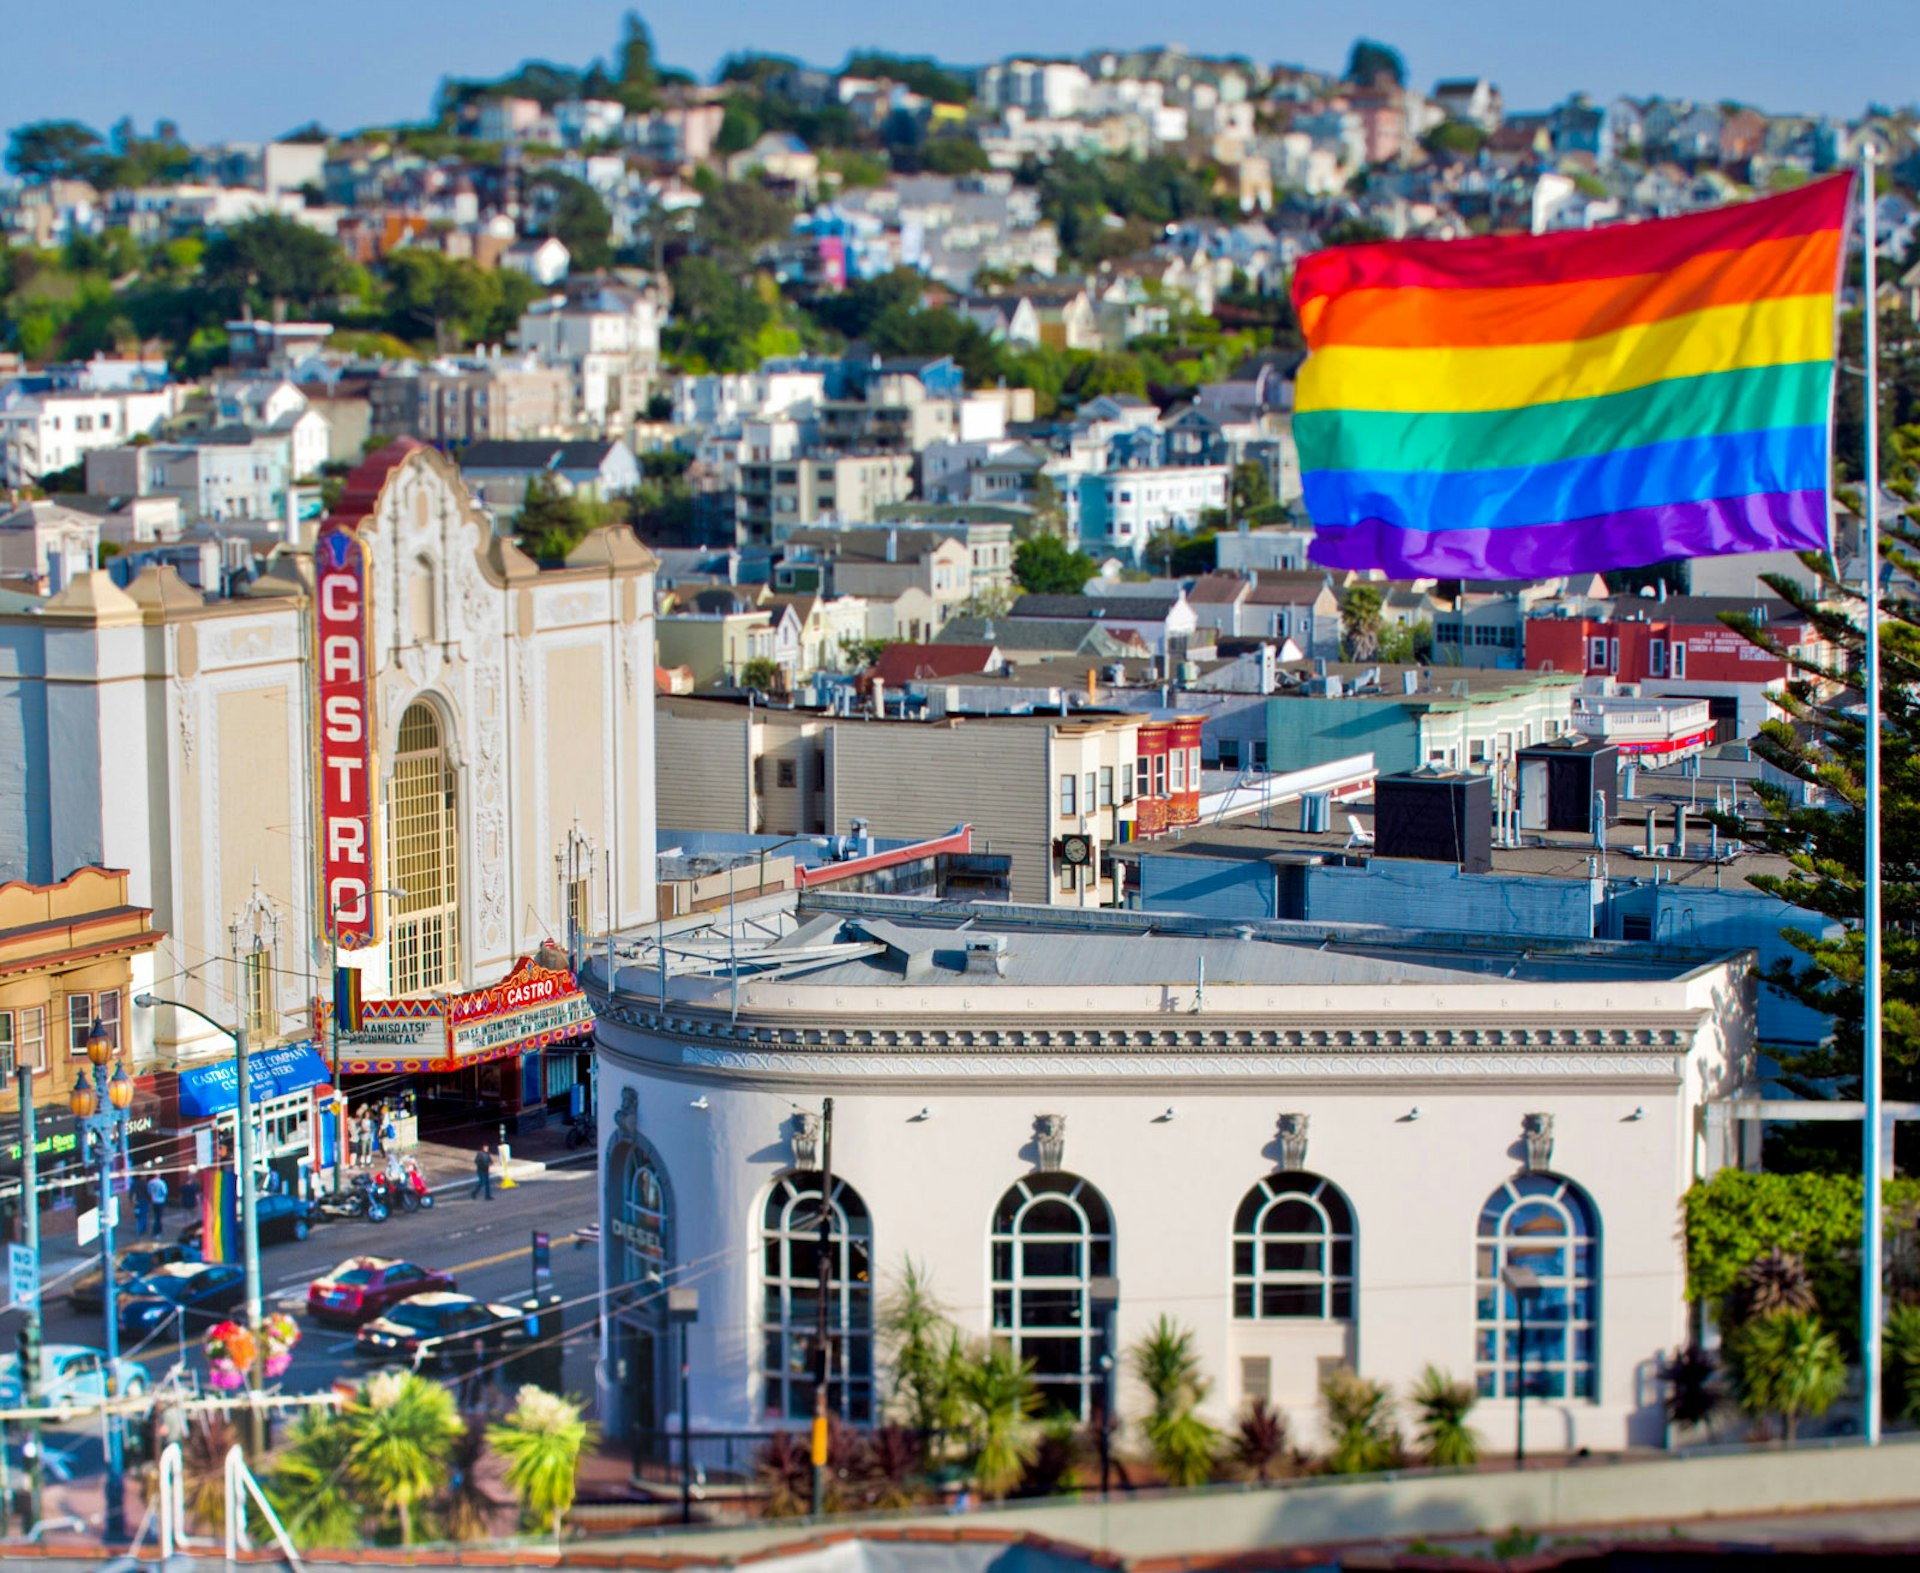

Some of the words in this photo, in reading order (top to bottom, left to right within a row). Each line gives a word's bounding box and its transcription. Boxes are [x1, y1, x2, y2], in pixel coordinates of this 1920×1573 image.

[322, 574, 367, 923] CASTRO
[506, 980, 553, 1004] CASTRO
[191, 1068, 231, 1087] CASTRO
[265, 1047, 308, 1067] COMPANY
[612, 1219, 660, 1248] DIESEL
